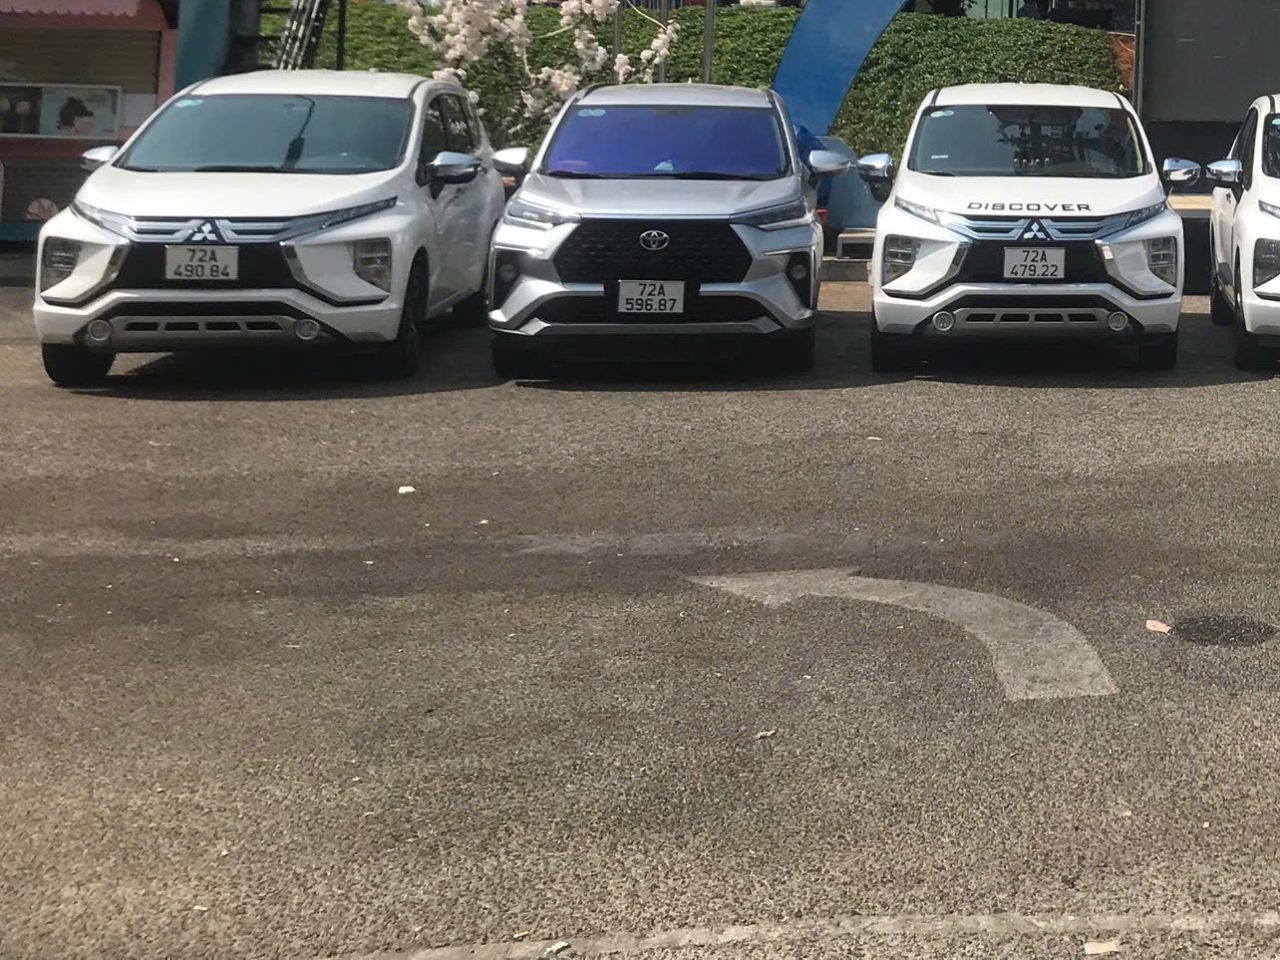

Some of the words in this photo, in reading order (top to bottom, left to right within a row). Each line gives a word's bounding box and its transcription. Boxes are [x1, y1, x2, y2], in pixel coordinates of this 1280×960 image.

[967, 201, 1093, 212] DISCOVER
[187, 248, 218, 263] 72A
[1022, 250, 1048, 263] 72A
[174, 264, 230, 278] 490.84
[1010, 264, 1058, 277] 479.22
[638, 283, 666, 297] 72A
[625, 298, 677, 312] 596.87
